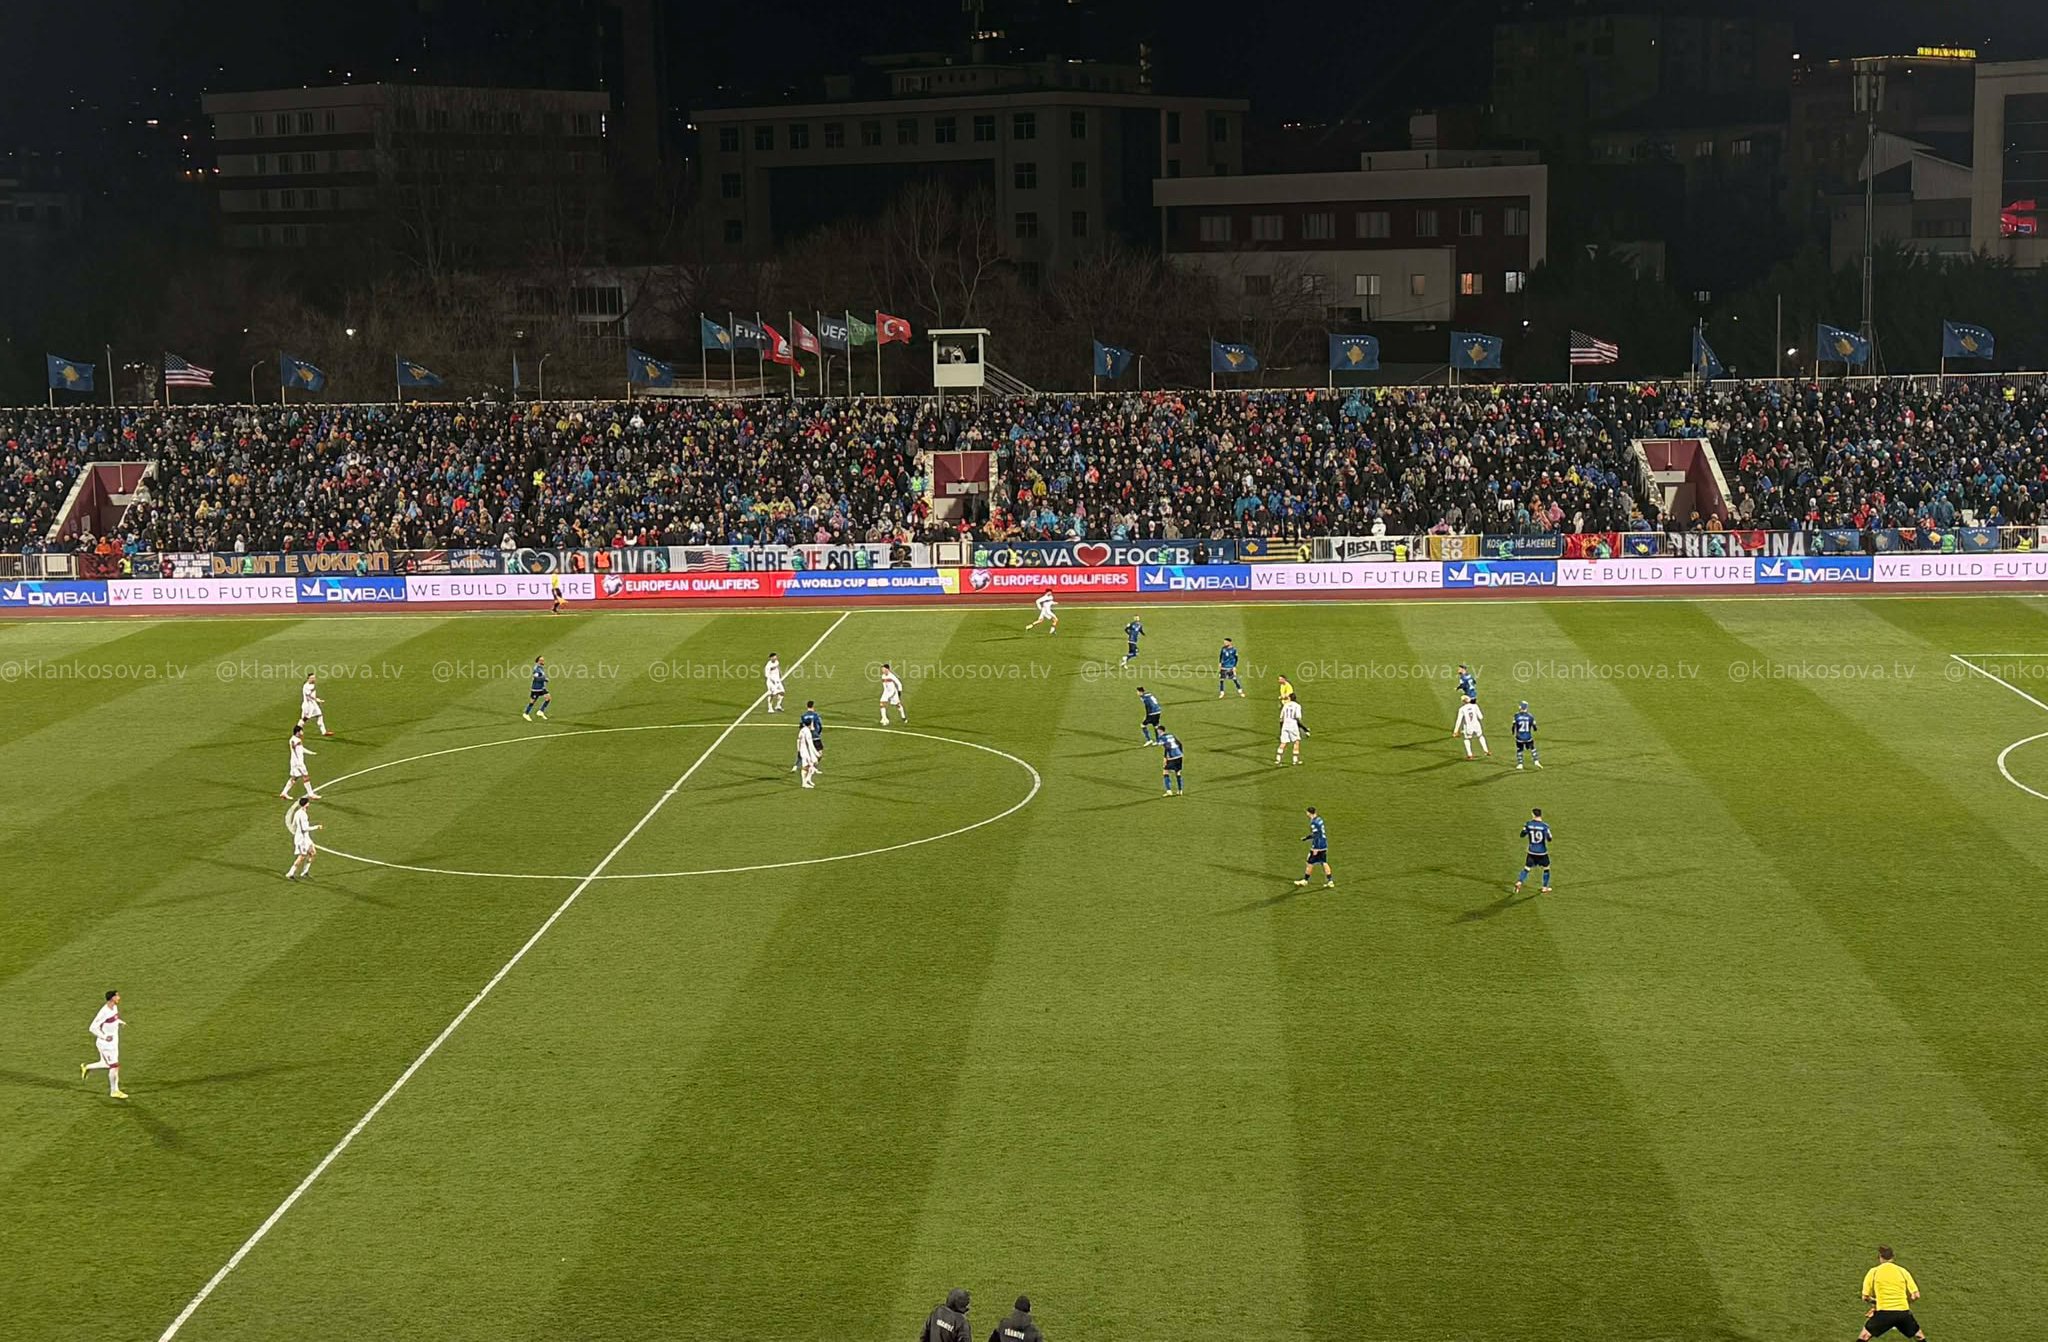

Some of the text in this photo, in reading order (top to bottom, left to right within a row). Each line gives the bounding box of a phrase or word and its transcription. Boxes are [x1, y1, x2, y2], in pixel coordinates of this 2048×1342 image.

[1563, 566, 1753, 581] WE BUILD FUTURE
[1879, 564, 1911, 577] WE
[1921, 563, 1983, 576] BUILD
[776, 579, 801, 589] FIFA
[801, 578, 842, 588] WORLD
[843, 577, 866, 588] CUP
[891, 576, 953, 587] QUALIFIERS
[993, 573, 1129, 587] EUROPEAN QUALIFIERS
[1256, 570, 1441, 585] WE BUILD FUTURE
[411, 584, 441, 597] WE
[450, 583, 507, 596] BUILD
[625, 579, 760, 592] EUROPEAN QUALIFIERS
[114, 586, 295, 600] WE BUILD FUTURE
[1518, 721, 1529, 732] 21
[1529, 830, 1543, 843] 19
